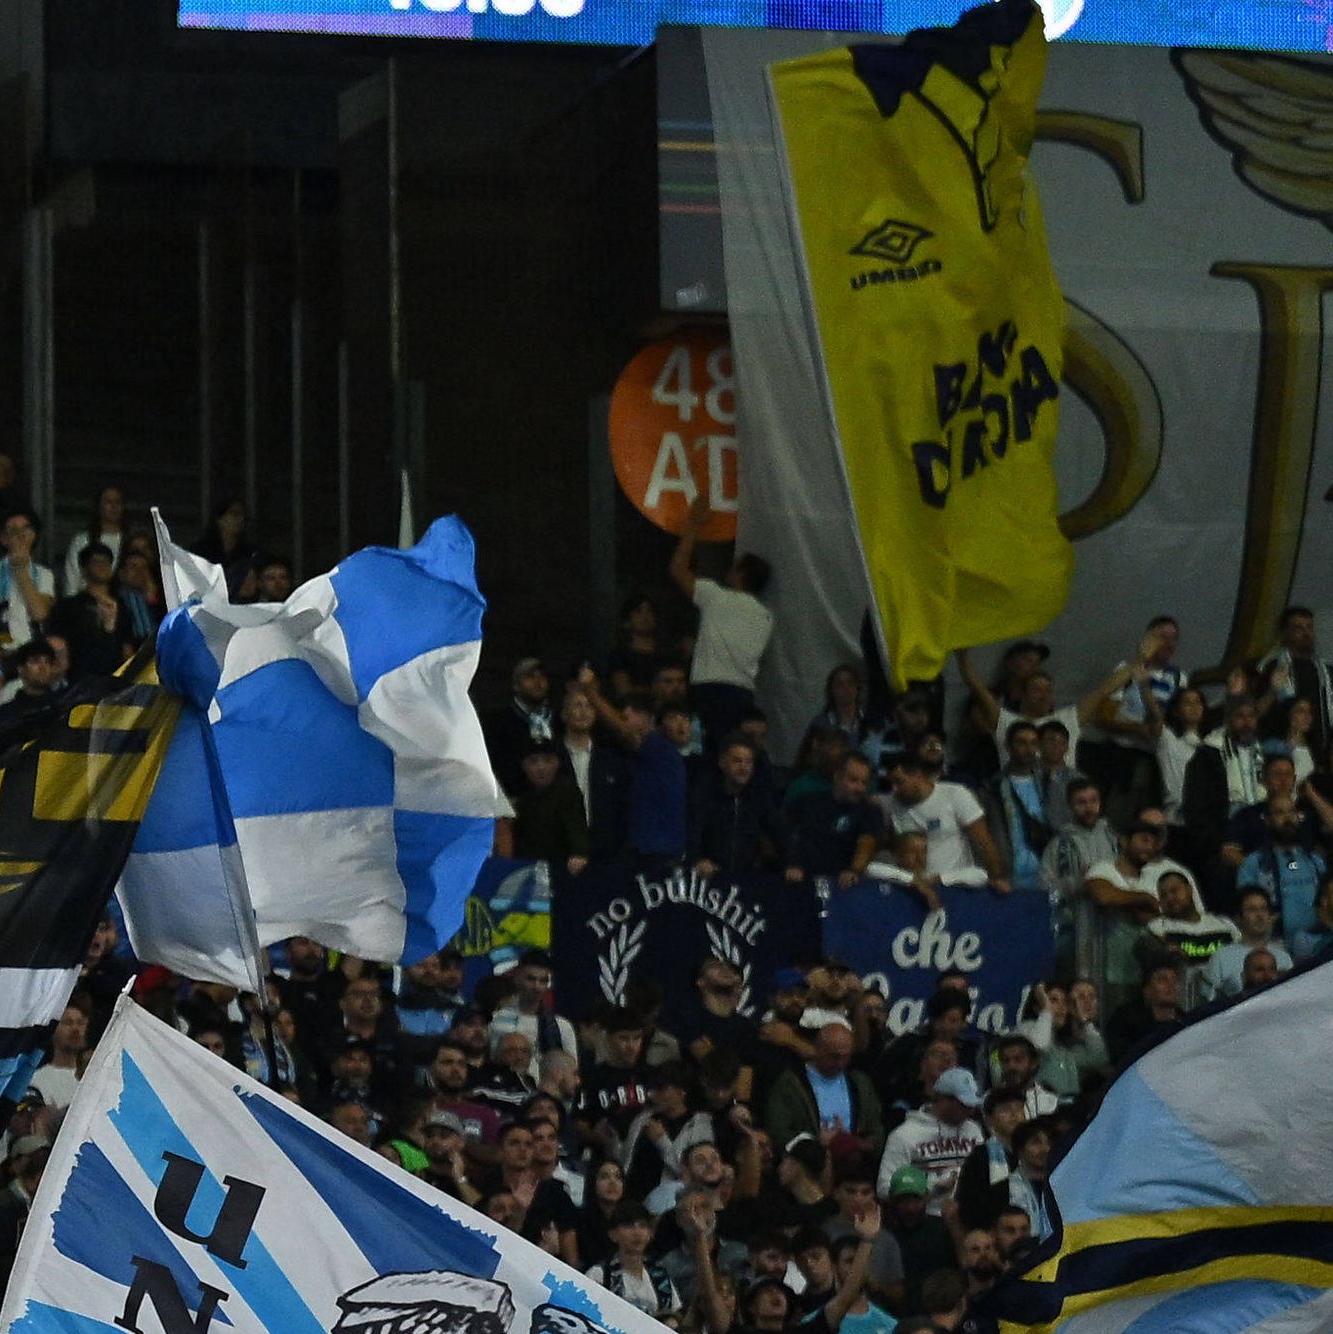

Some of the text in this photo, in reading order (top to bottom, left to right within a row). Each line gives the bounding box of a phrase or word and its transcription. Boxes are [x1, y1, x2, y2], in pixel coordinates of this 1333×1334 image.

[586, 867, 767, 946] no bullshit
[891, 907, 986, 973] che
